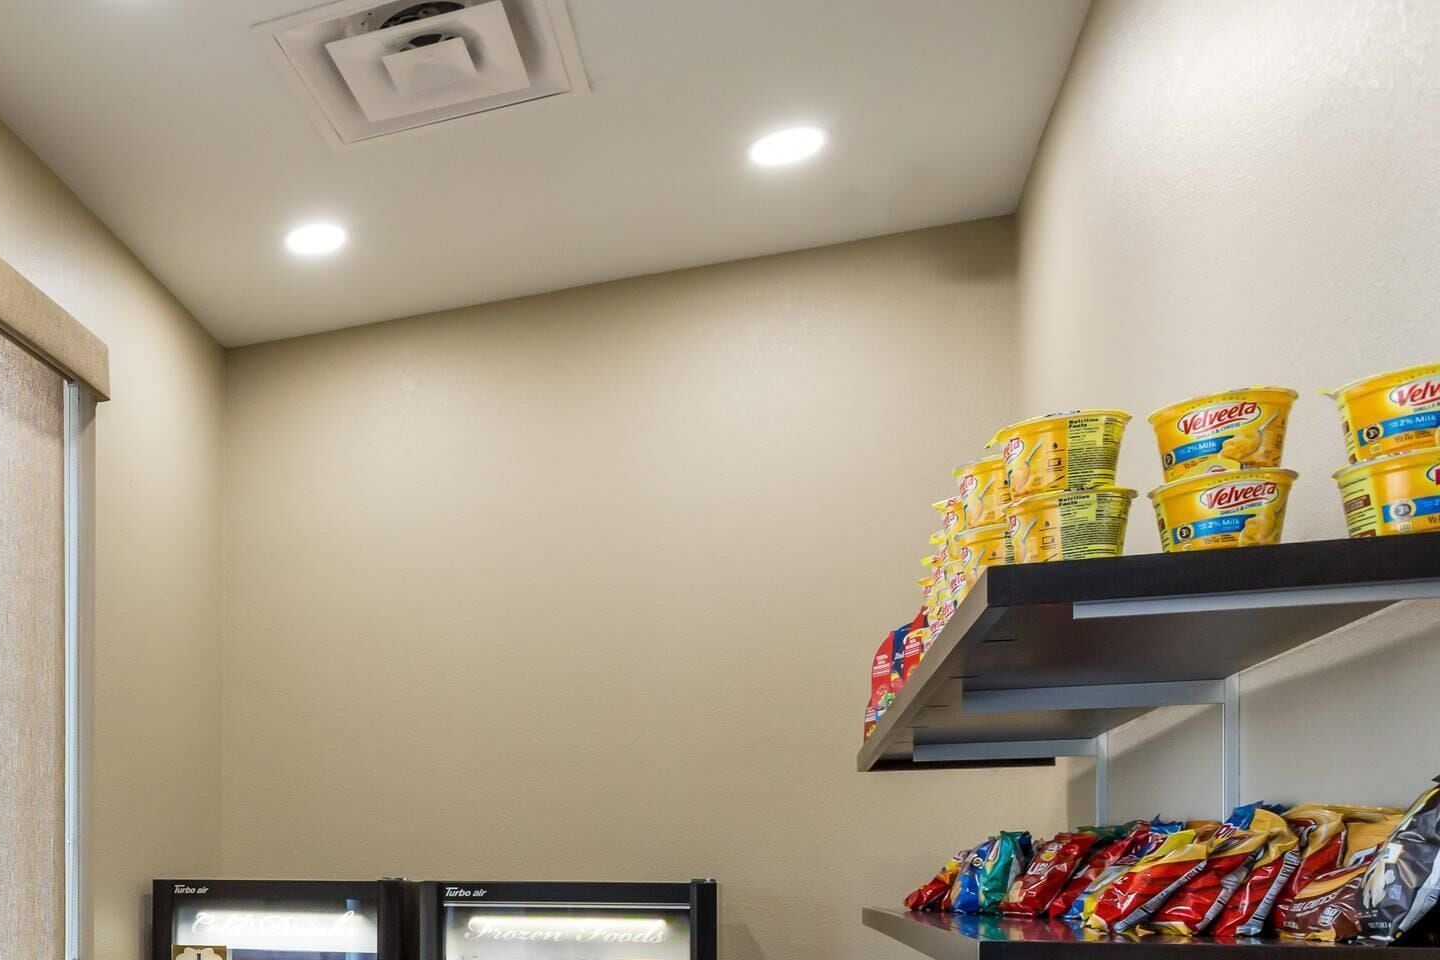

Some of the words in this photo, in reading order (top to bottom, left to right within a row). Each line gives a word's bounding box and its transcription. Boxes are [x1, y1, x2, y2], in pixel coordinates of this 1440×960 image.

[1182, 401, 1257, 435] Velveeta
[1206, 482, 1278, 509] Velveeta
[174, 884, 196, 894] Turbo
[197, 886, 209, 894] air
[445, 886, 471, 897] Turbo
[472, 888, 488, 897] air
[463, 917, 568, 942] Frozen
[575, 917, 667, 943] Foods
